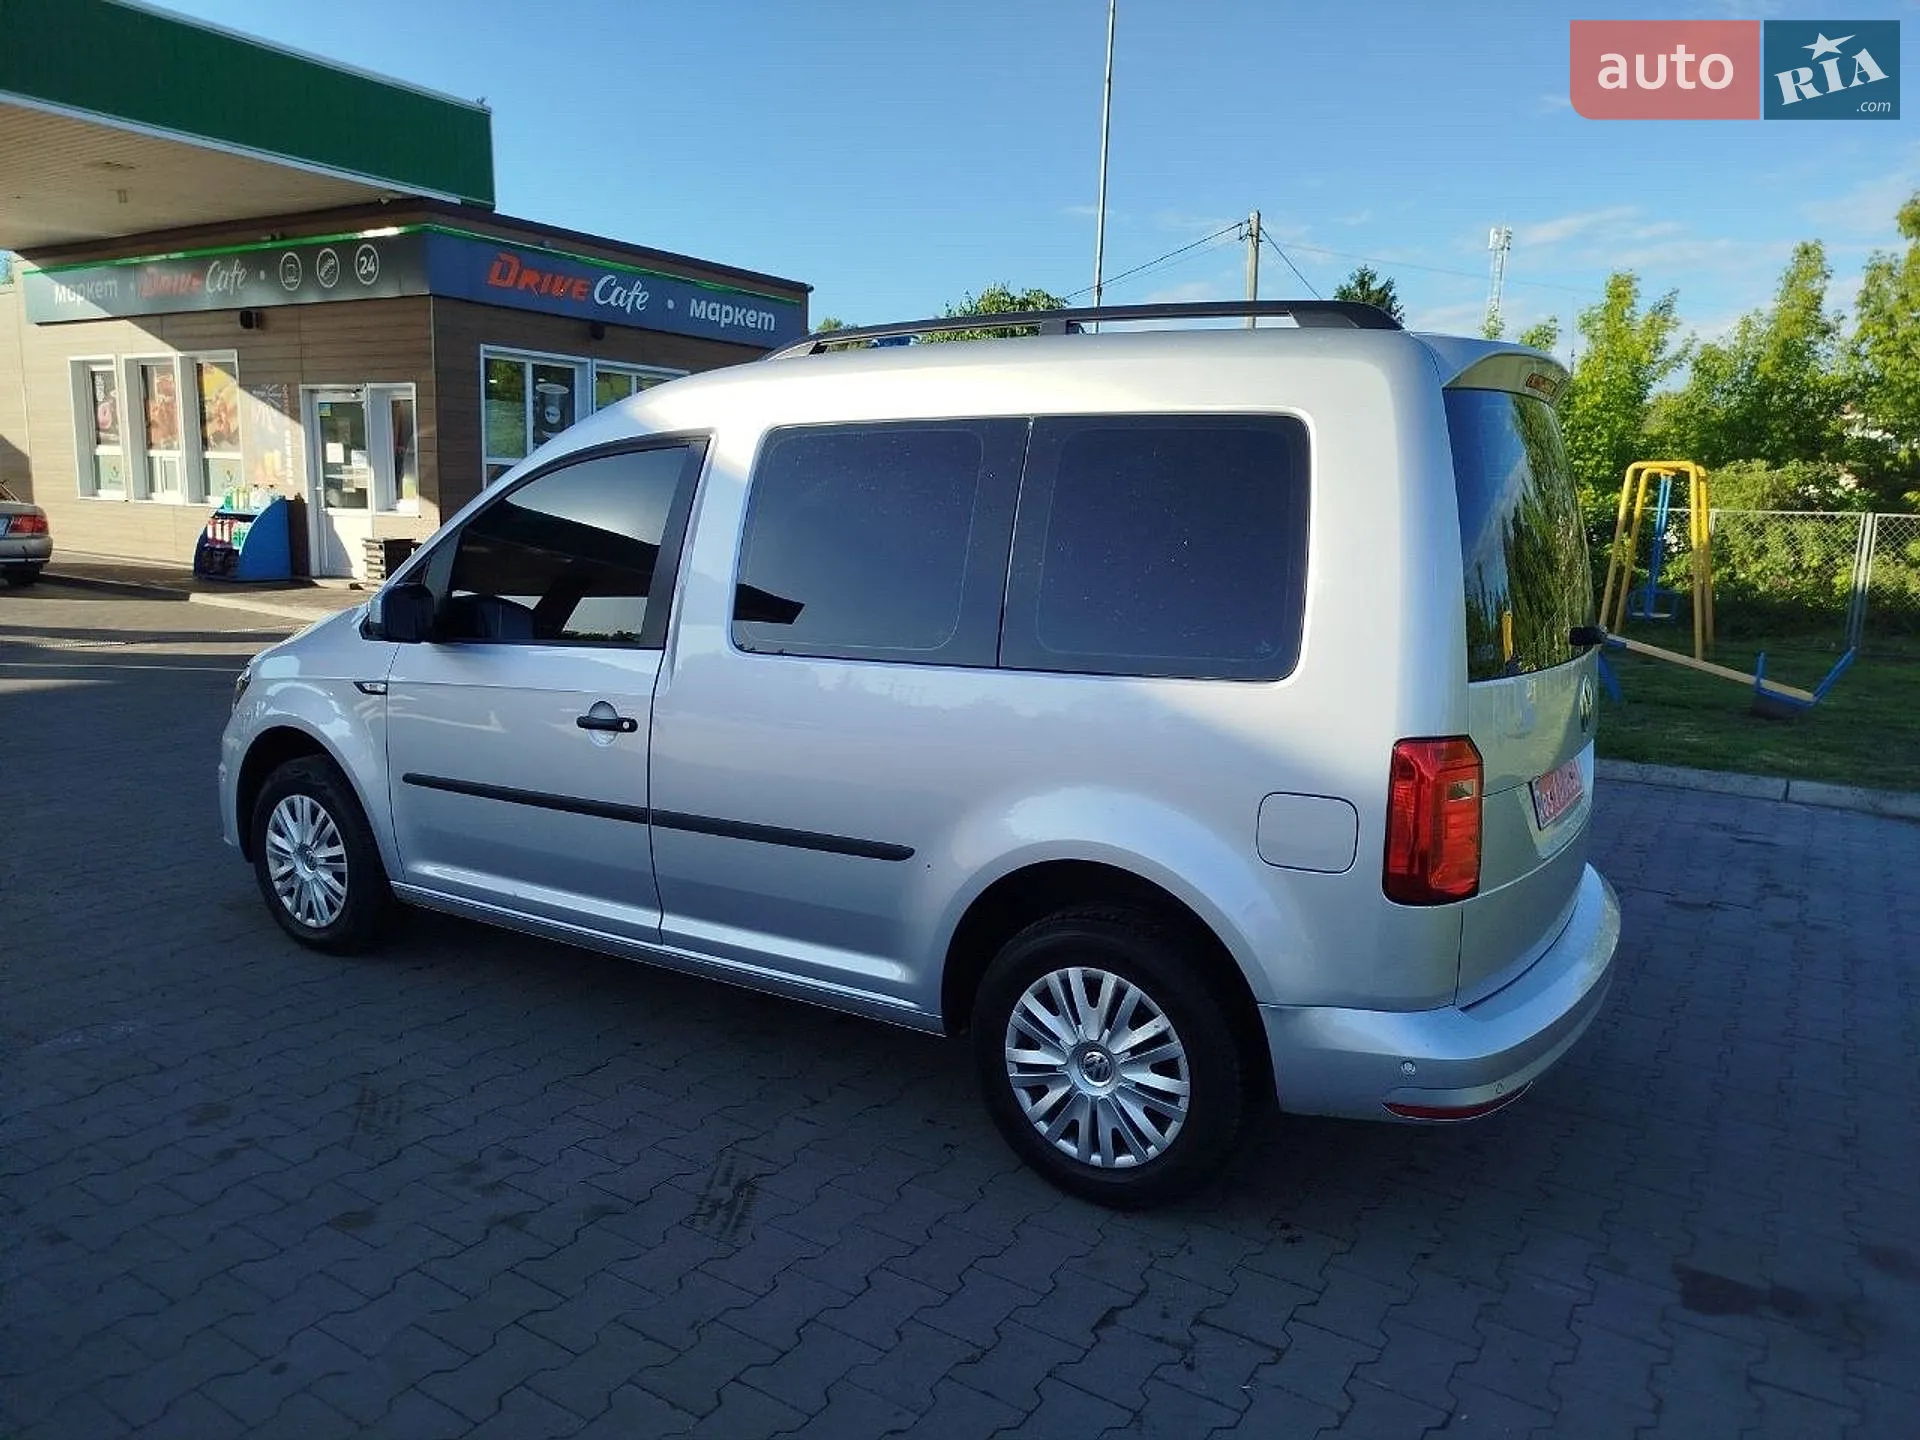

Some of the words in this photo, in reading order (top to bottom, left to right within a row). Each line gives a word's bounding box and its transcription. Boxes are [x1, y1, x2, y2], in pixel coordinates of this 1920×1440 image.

[206, 259, 247, 296] Cafe
[360, 255, 376, 274] 24
[594, 274, 649, 314] Cafe
